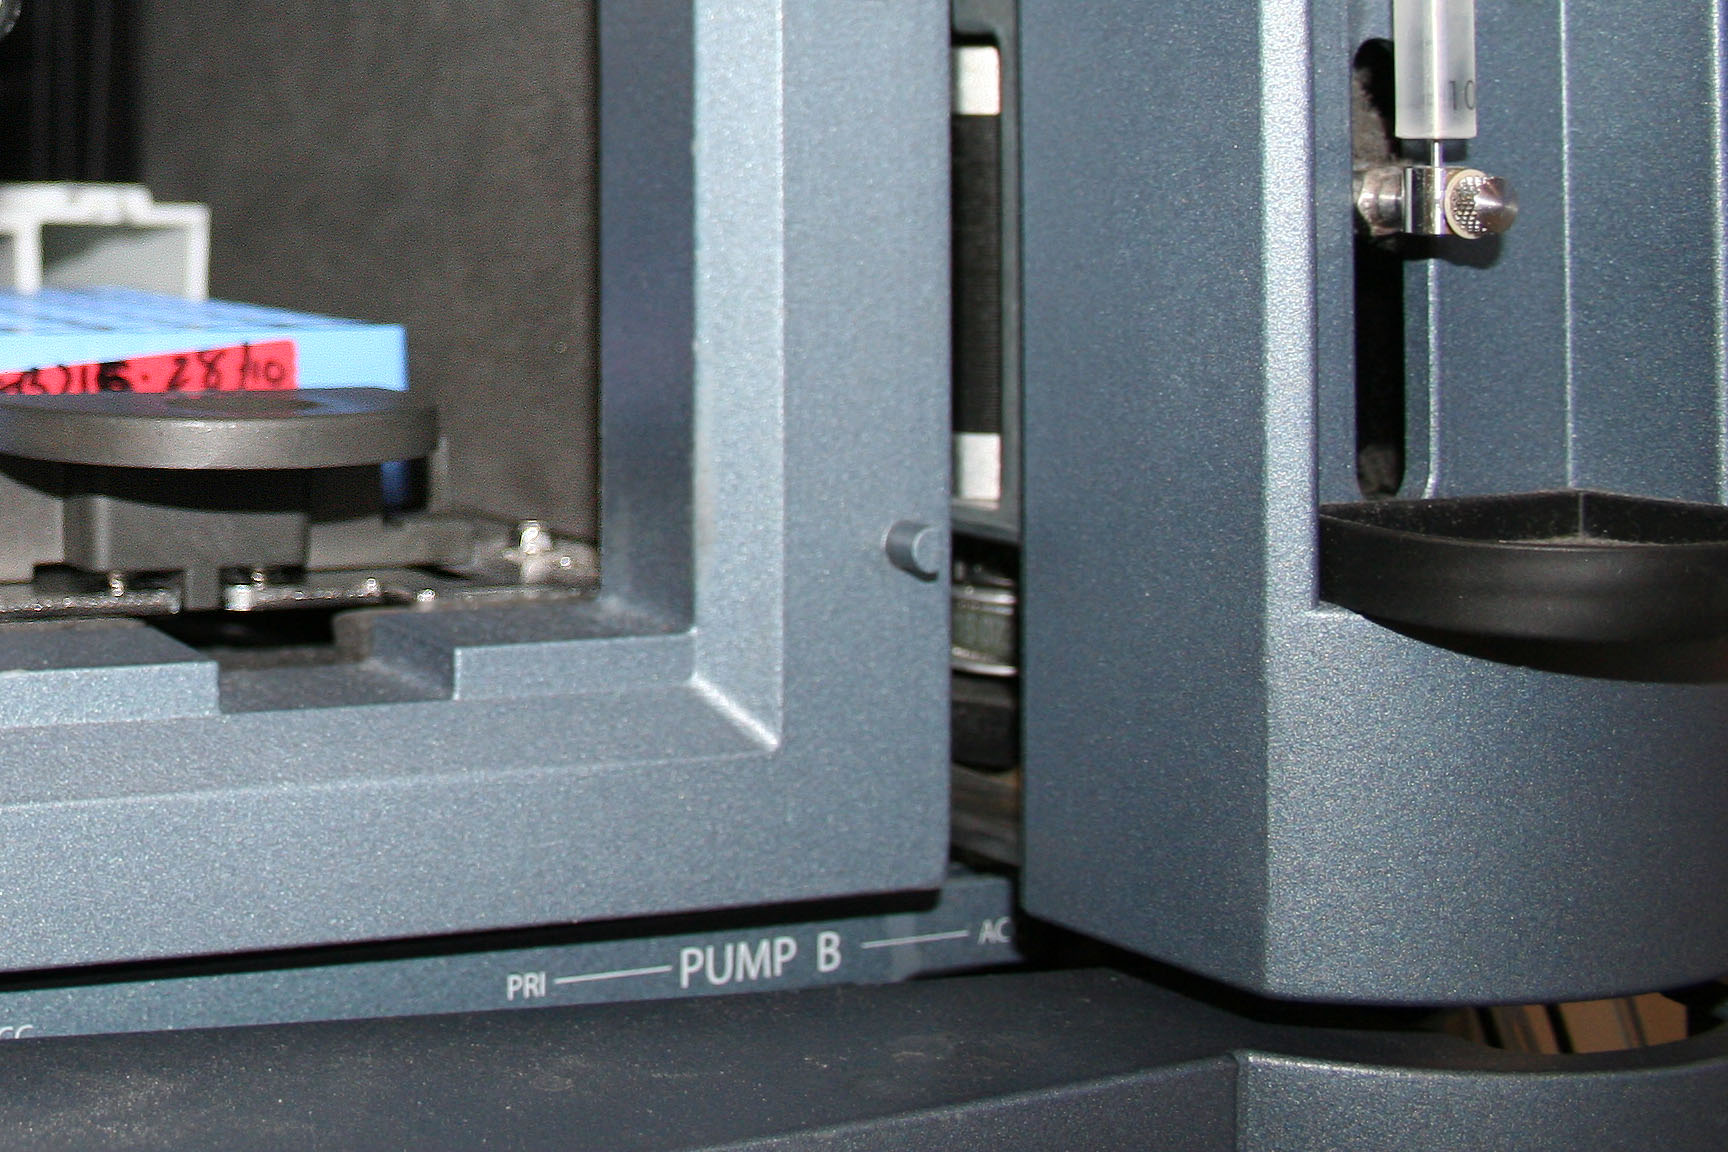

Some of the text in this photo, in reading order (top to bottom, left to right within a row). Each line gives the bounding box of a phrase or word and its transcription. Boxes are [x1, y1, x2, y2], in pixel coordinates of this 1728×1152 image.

[506, 971, 547, 1002] PRI
[679, 935, 797, 989] PUMP
[816, 931, 842, 973] B
